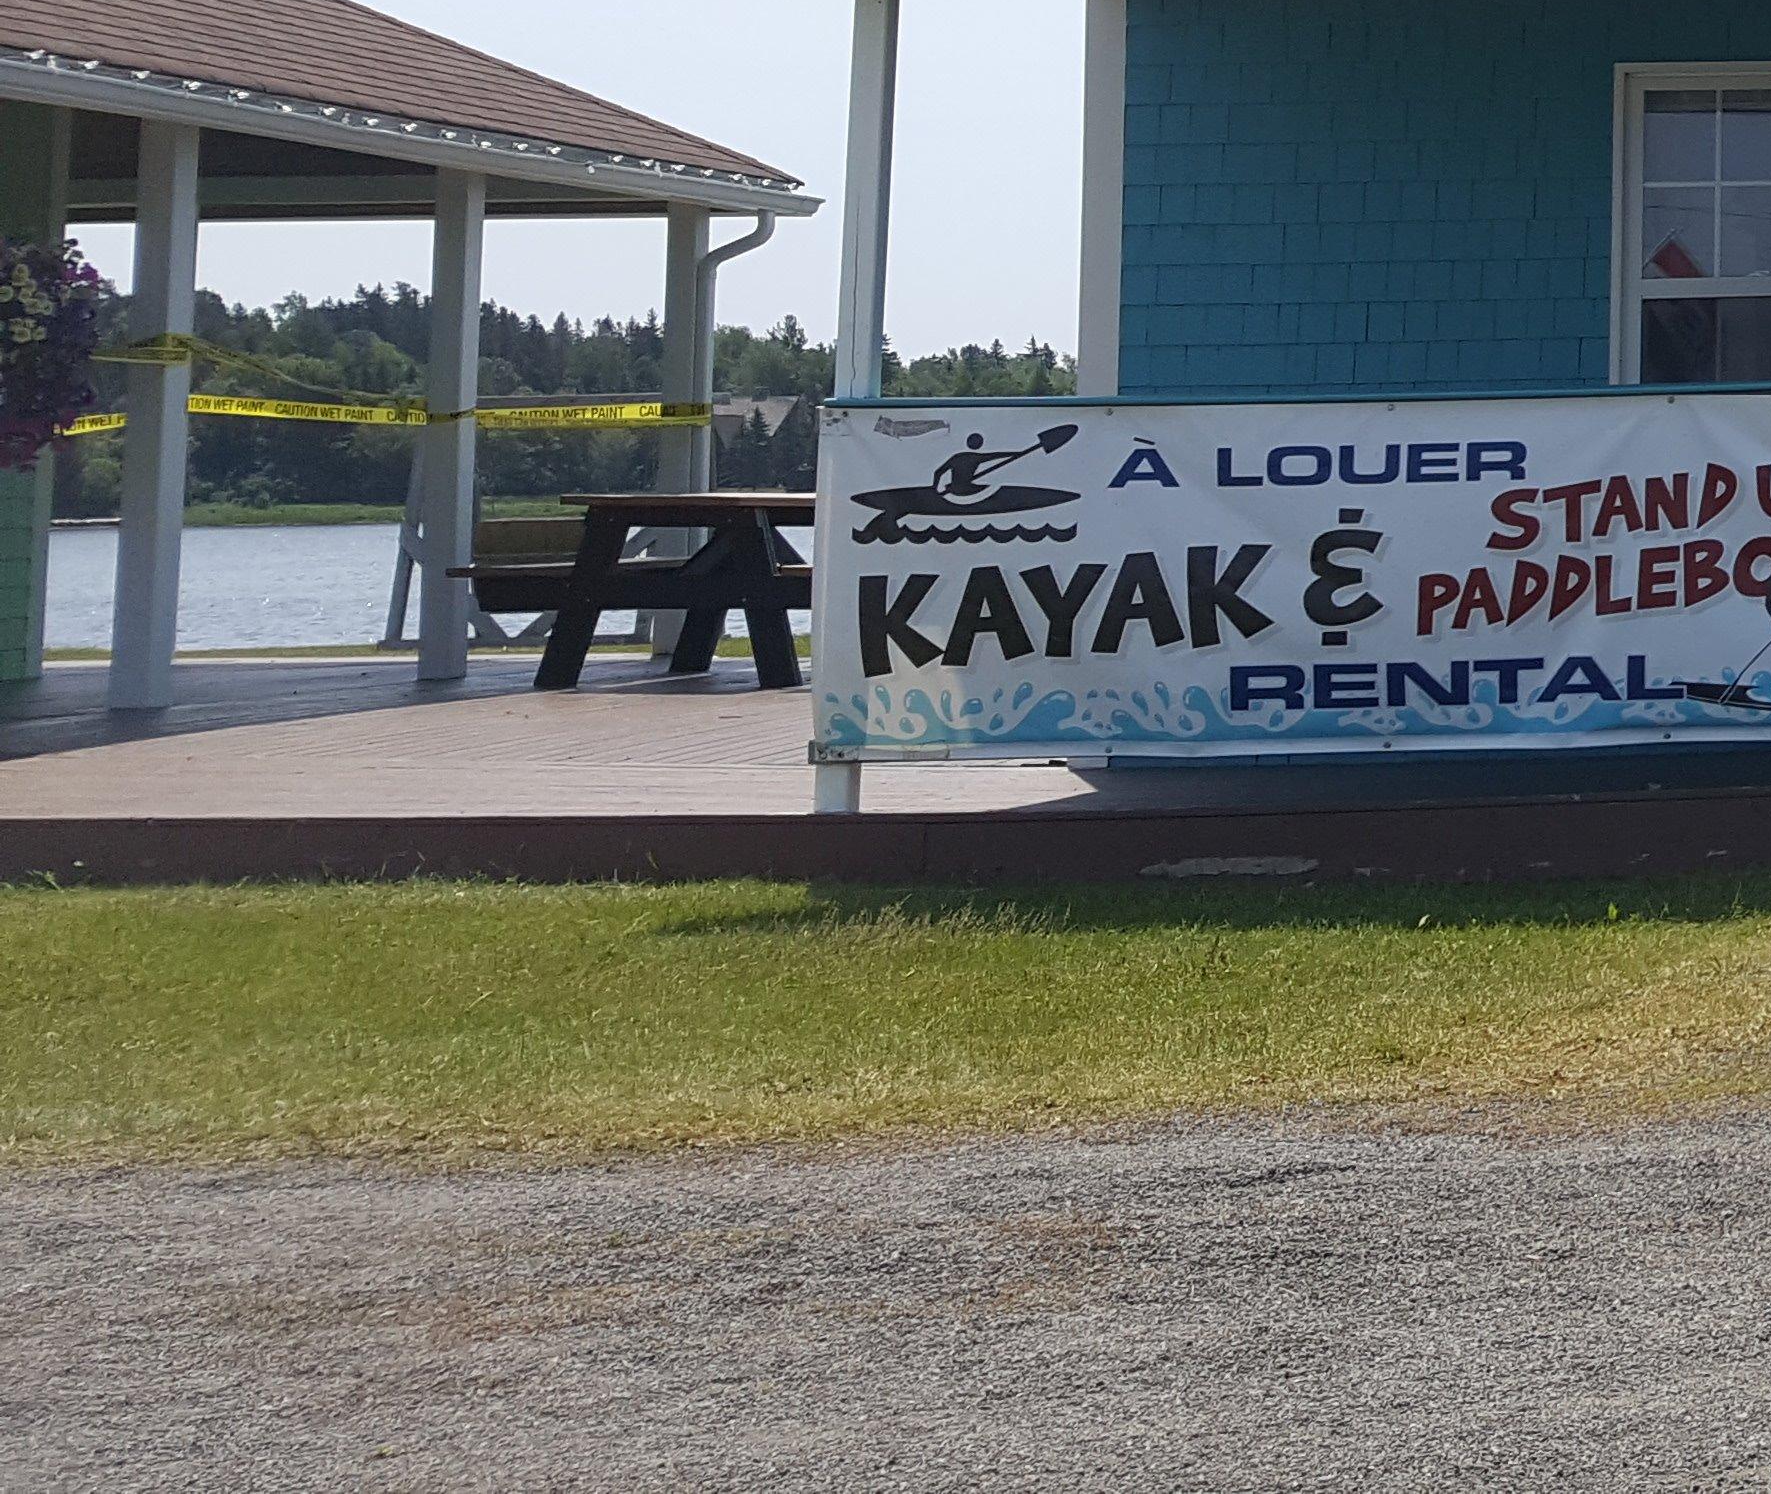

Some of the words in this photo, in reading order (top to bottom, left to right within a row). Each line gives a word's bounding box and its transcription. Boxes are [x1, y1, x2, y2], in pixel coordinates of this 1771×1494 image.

[213, 398, 233, 411] WET
[236, 399, 265, 413] PAINT
[275, 402, 318, 418] CAUTION
[320, 406, 341, 419] WET
[344, 408, 374, 421] PAINT
[591, 405, 626, 419] PAINT
[1107, 436, 1180, 488] À
[1216, 441, 1527, 488] LOUER
[1485, 462, 1738, 551] STAND
[858, 542, 1275, 678] KAYAK
[1303, 507, 1385, 647] &
[1228, 654, 1687, 712] RENTAL
